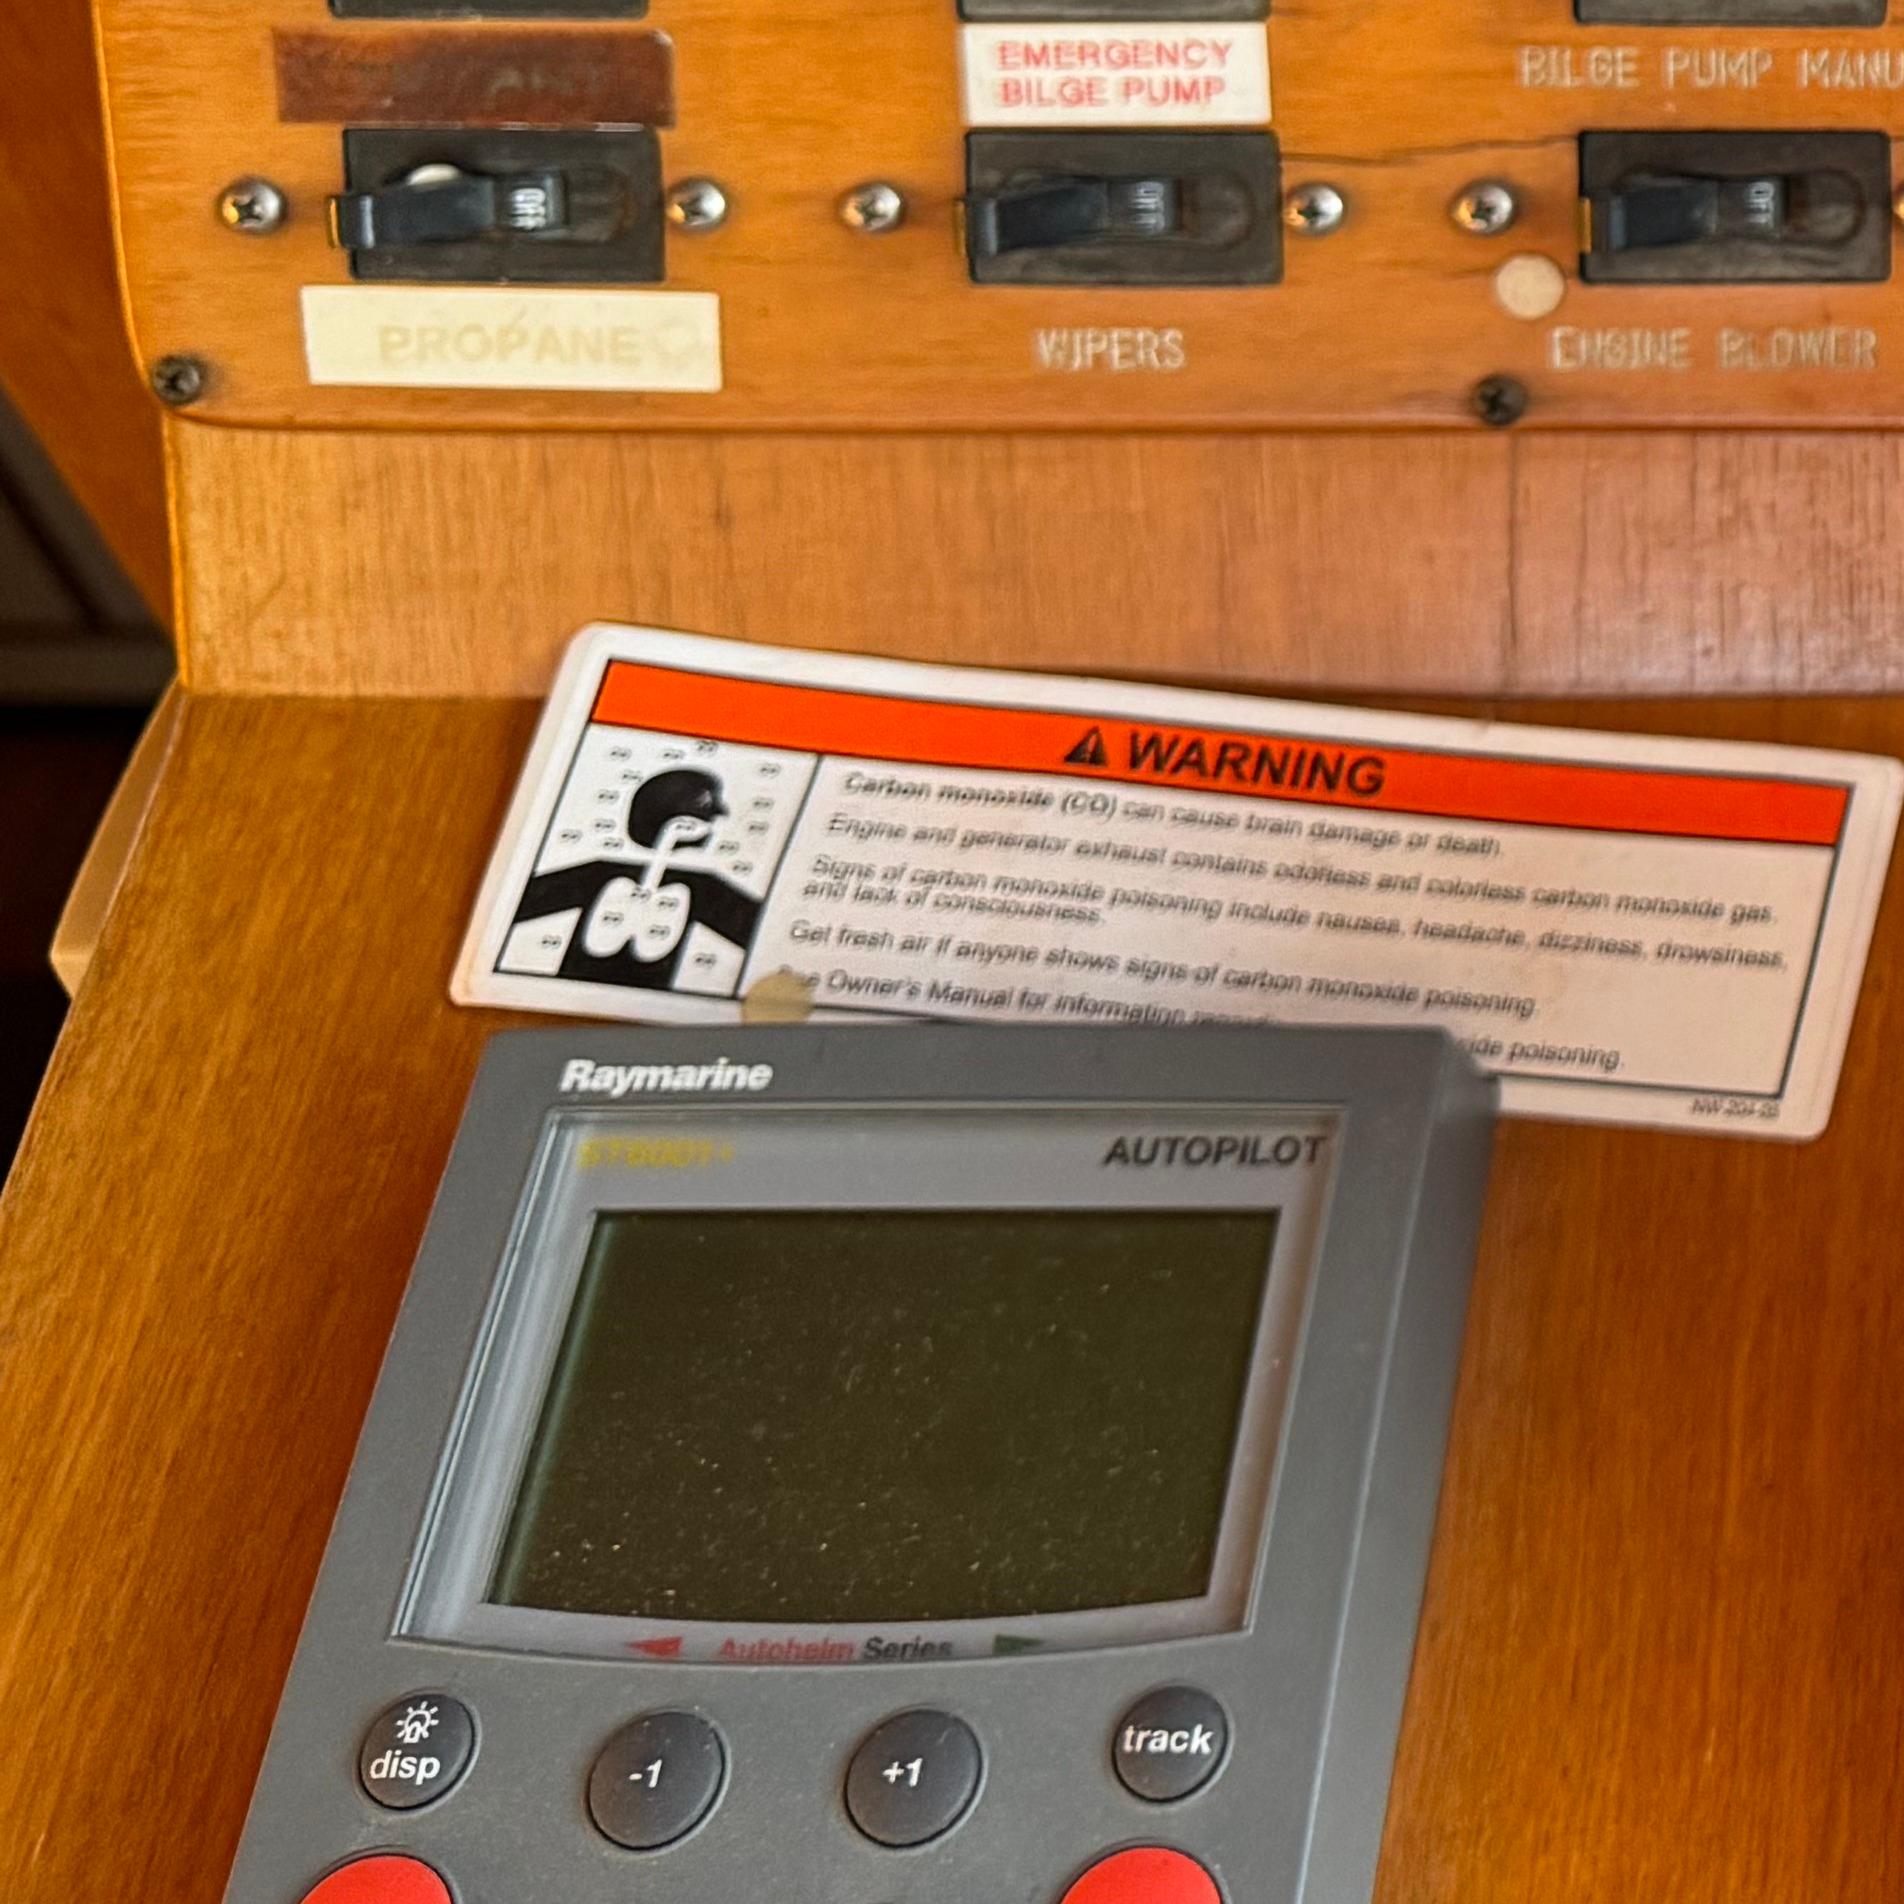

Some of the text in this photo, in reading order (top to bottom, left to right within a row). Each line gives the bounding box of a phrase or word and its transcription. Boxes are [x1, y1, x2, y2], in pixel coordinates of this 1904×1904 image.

[999, 39, 1233, 71] EMERGENCY
[1520, 46, 1639, 88] BILGE
[1665, 48, 1773, 89] PUMP
[999, 76, 1227, 108] BILGE PUMP
[378, 322, 642, 365] PROPANE
[1036, 329, 1186, 370] WIPERS
[1549, 328, 1878, 368] ENGINE BLOWER
[1127, 732, 1386, 797] WARNING
[560, 1058, 773, 1103] Raymarine
[1102, 1134, 1328, 1168] AUTOPILOT
[717, 1635, 954, 1662] Autohelm Series
[1121, 1723, 1213, 1756] track
[368, 1748, 441, 1786] disp
[630, 1758, 663, 1789] -1
[882, 1758, 923, 1788] +1
